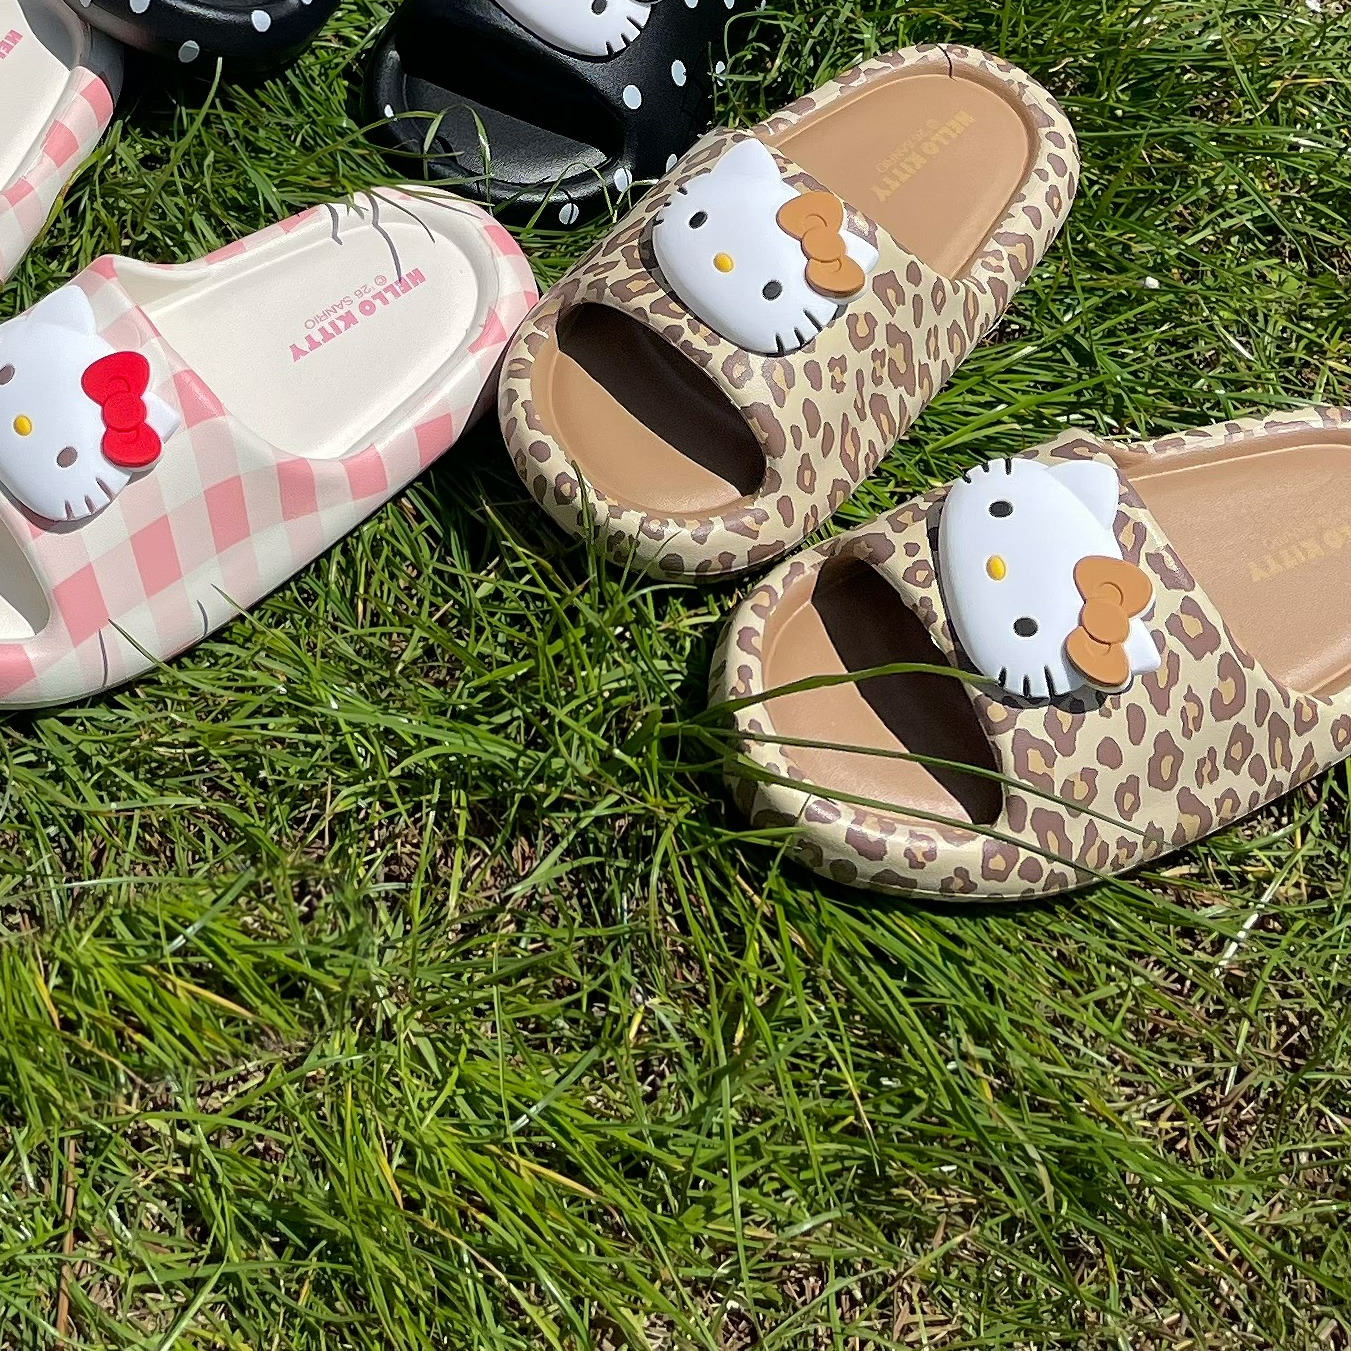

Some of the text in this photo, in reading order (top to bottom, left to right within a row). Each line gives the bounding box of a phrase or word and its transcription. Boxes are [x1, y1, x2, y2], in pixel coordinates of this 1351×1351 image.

[870, 109, 975, 202] HELLO KITTY
[289, 267, 427, 363] HELLO KITTY
[304, 296, 354, 330] SANRIO
